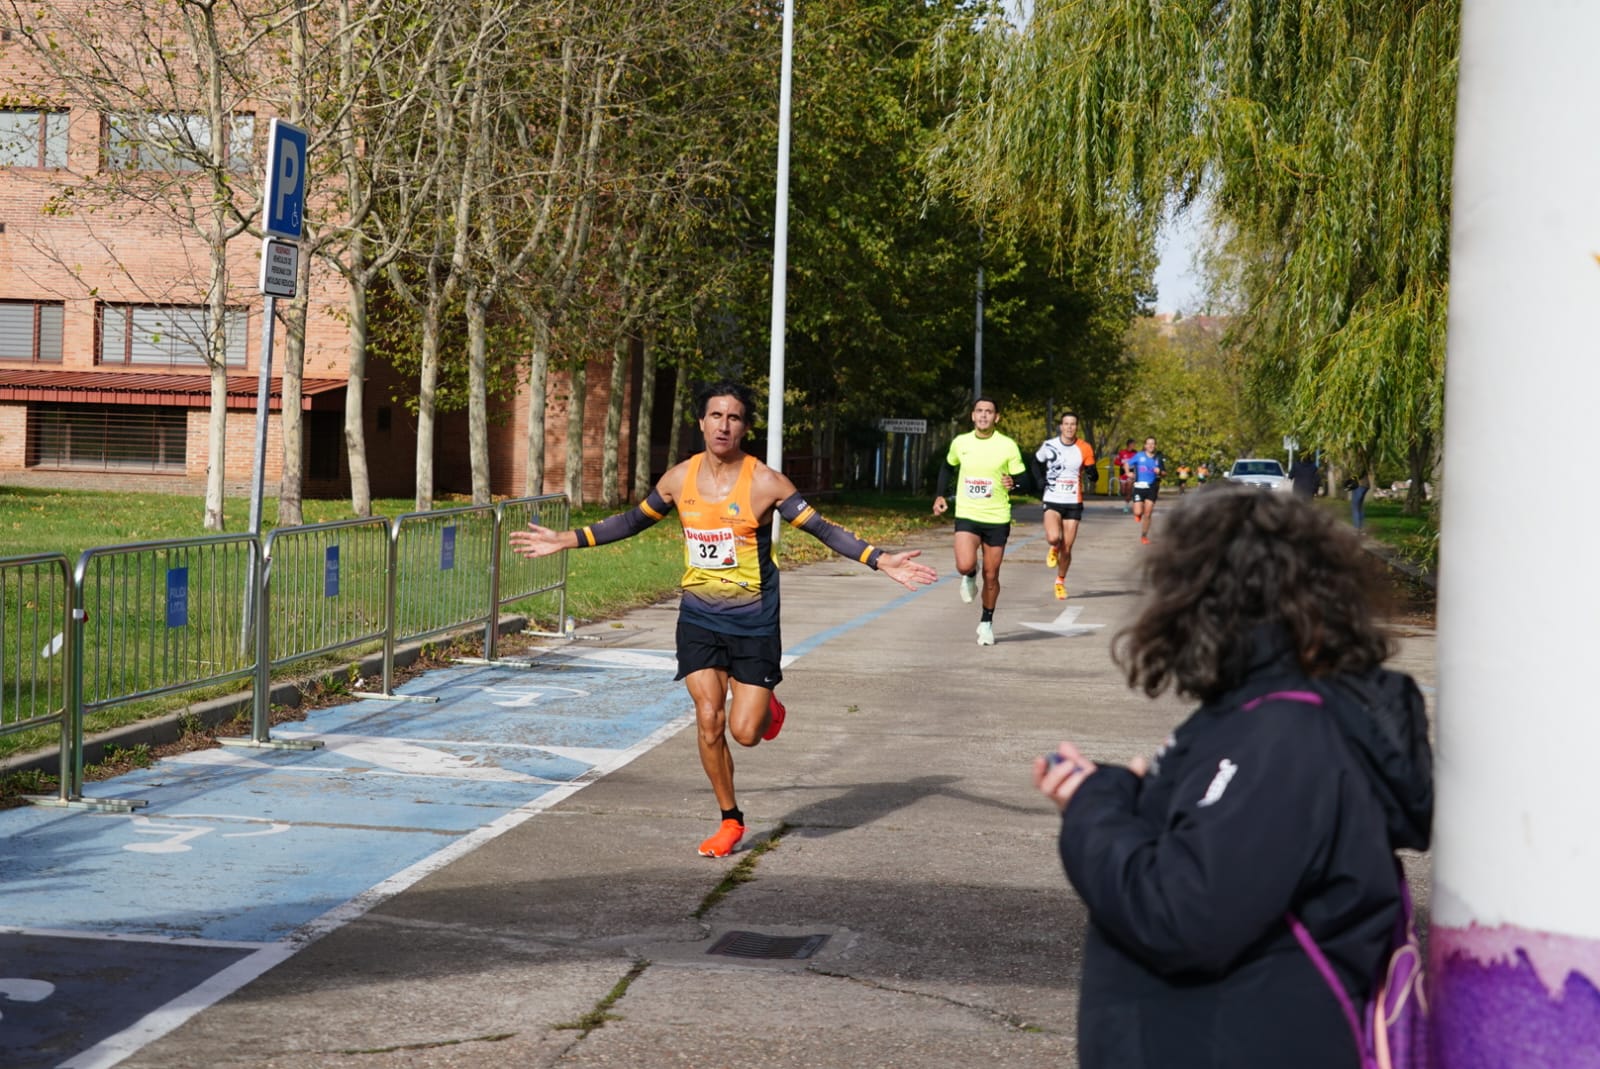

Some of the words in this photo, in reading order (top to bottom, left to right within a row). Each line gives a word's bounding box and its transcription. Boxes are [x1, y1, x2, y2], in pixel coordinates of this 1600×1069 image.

[276, 138, 299, 220] P
[969, 485, 987, 494] 205
[699, 543, 718, 559] 32
